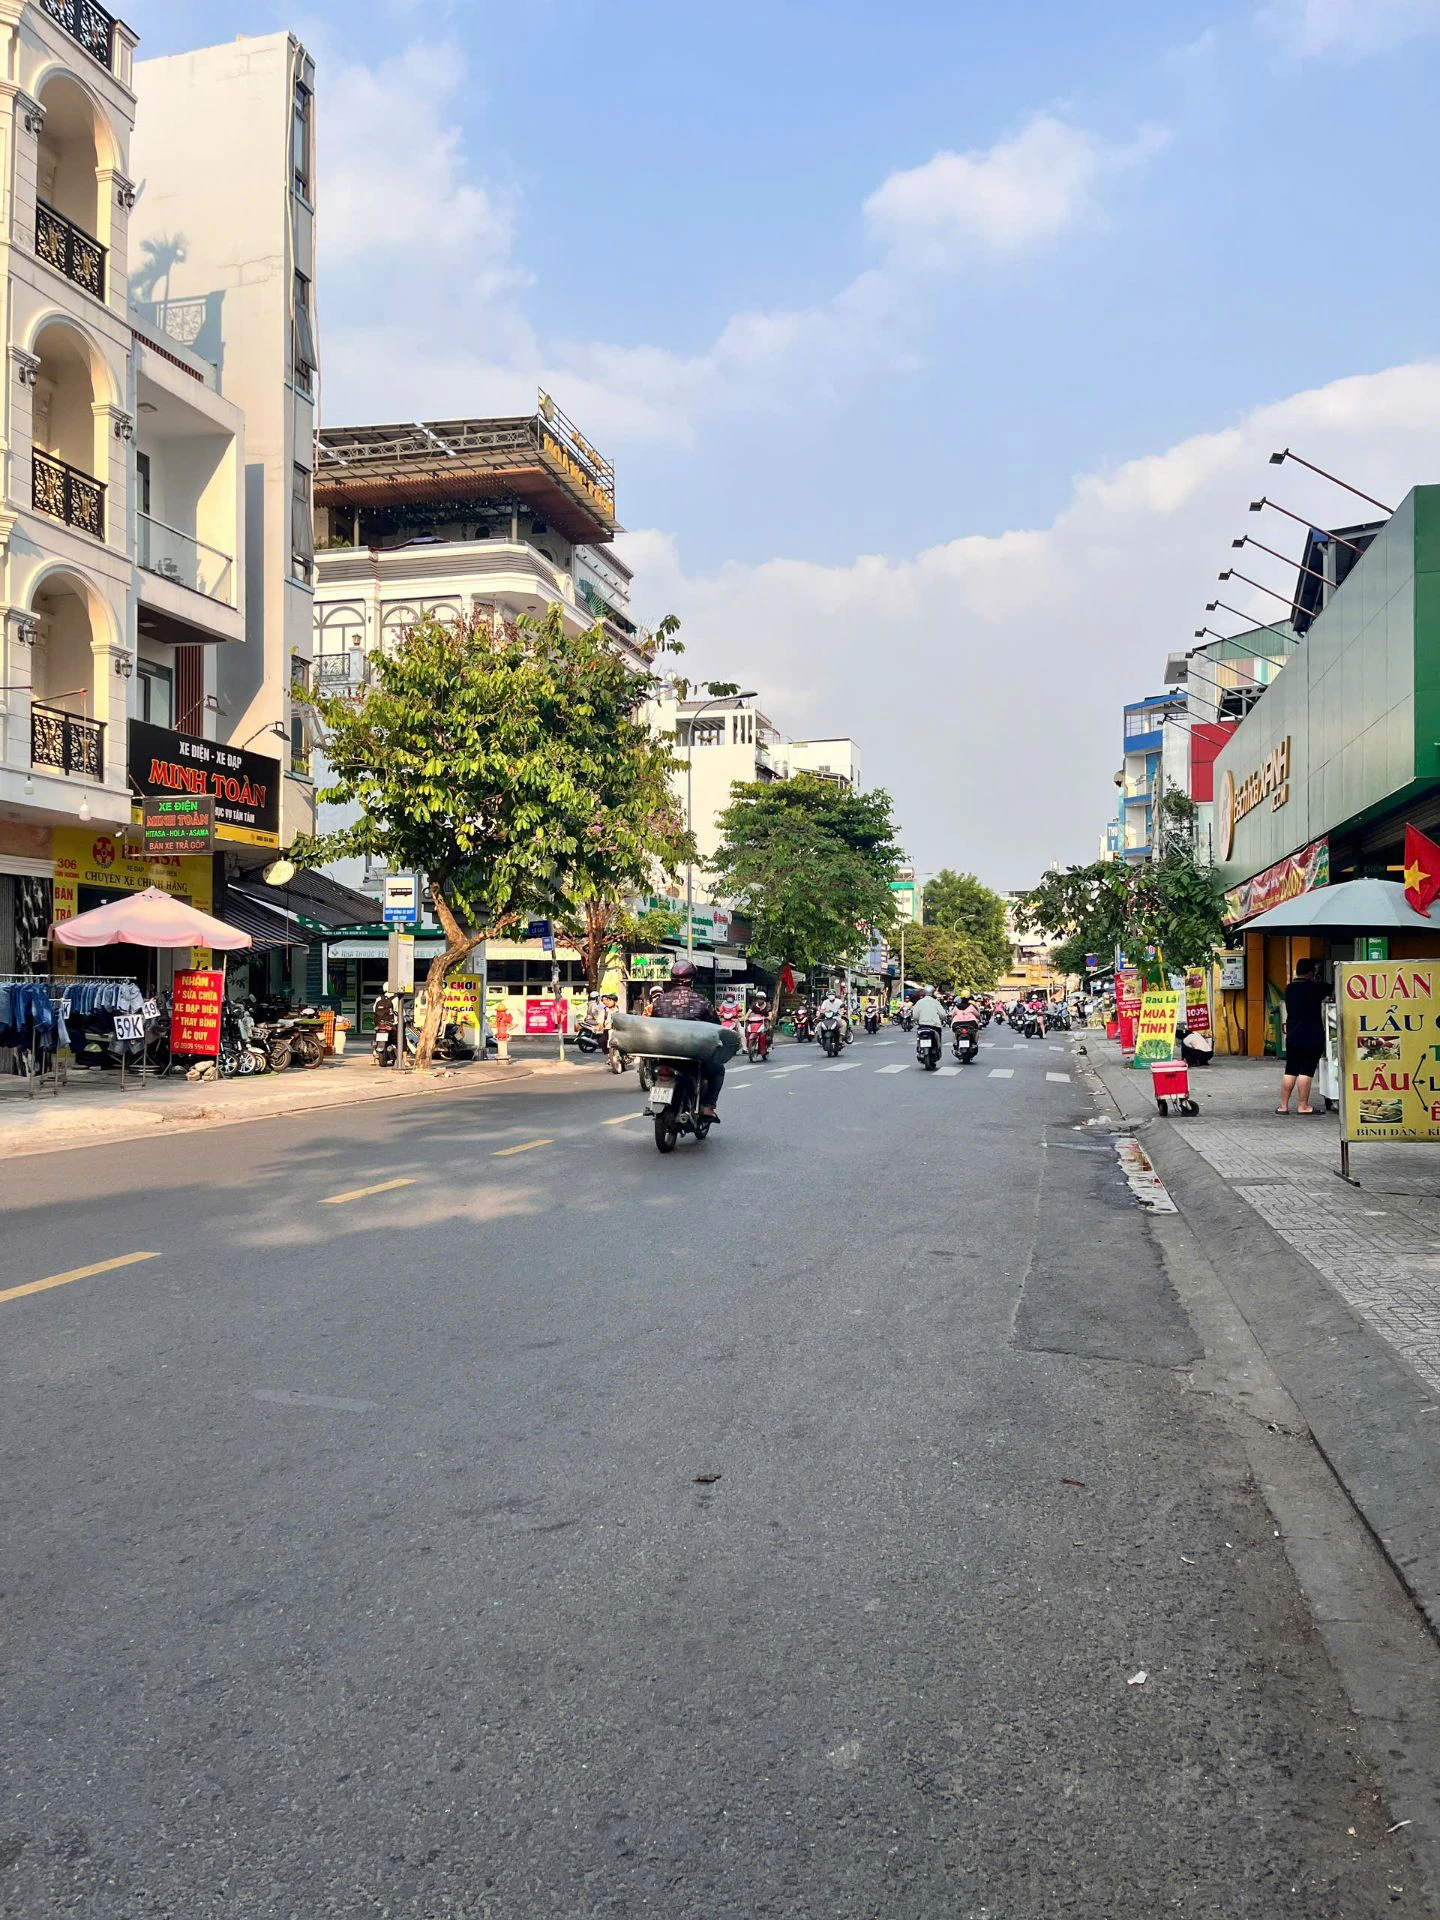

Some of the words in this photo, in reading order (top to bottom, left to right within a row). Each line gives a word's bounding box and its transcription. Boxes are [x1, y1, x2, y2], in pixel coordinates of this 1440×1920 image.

[180, 740, 190, 756] XE
[216, 751, 226, 765] XE
[227, 754, 242, 771] ĐẠP
[148, 758, 207, 795] MINH
[211, 773, 267, 808] TOÀN
[159, 802, 172, 812] XE
[174, 800, 198, 812] ĐIỆN
[147, 816, 176, 827] MINH
[177, 812, 209, 826] TOÀN
[149, 842, 164, 850] BÁN
[175, 840, 189, 849] TRẢ
[190, 840, 205, 849] GÓP
[58, 858, 78, 870] 306
[124, 876, 135, 886] XE
[55, 886, 73, 901] BÁN
[182, 976, 208, 987] NHẬN
[450, 981, 476, 990] CHƠI
[1346, 967, 1432, 1000] QUÁN
[182, 990, 197, 1000] SỬA
[463, 993, 477, 1002] ÁO
[1145, 996, 1162, 1004] Rau
[175, 1004, 184, 1012] XE
[185, 1004, 200, 1014] ĐẠP
[202, 1003, 219, 1015] ĐIỆN
[1143, 1010, 1166, 1018] MUA
[1169, 1010, 1175, 1018] 2
[181, 1018, 197, 1027] THAY
[1360, 1004, 1424, 1032] LẨU
[116, 1018, 143, 1038] 59K
[1140, 1020, 1167, 1033] TÍNH
[1170, 1024, 1175, 1032] 1
[194, 1032, 208, 1041] QUY
[1352, 1062, 1410, 1091] LẨU
[1357, 1127, 1387, 1136] BÌNH
[1390, 1126, 1417, 1136] DÂN
